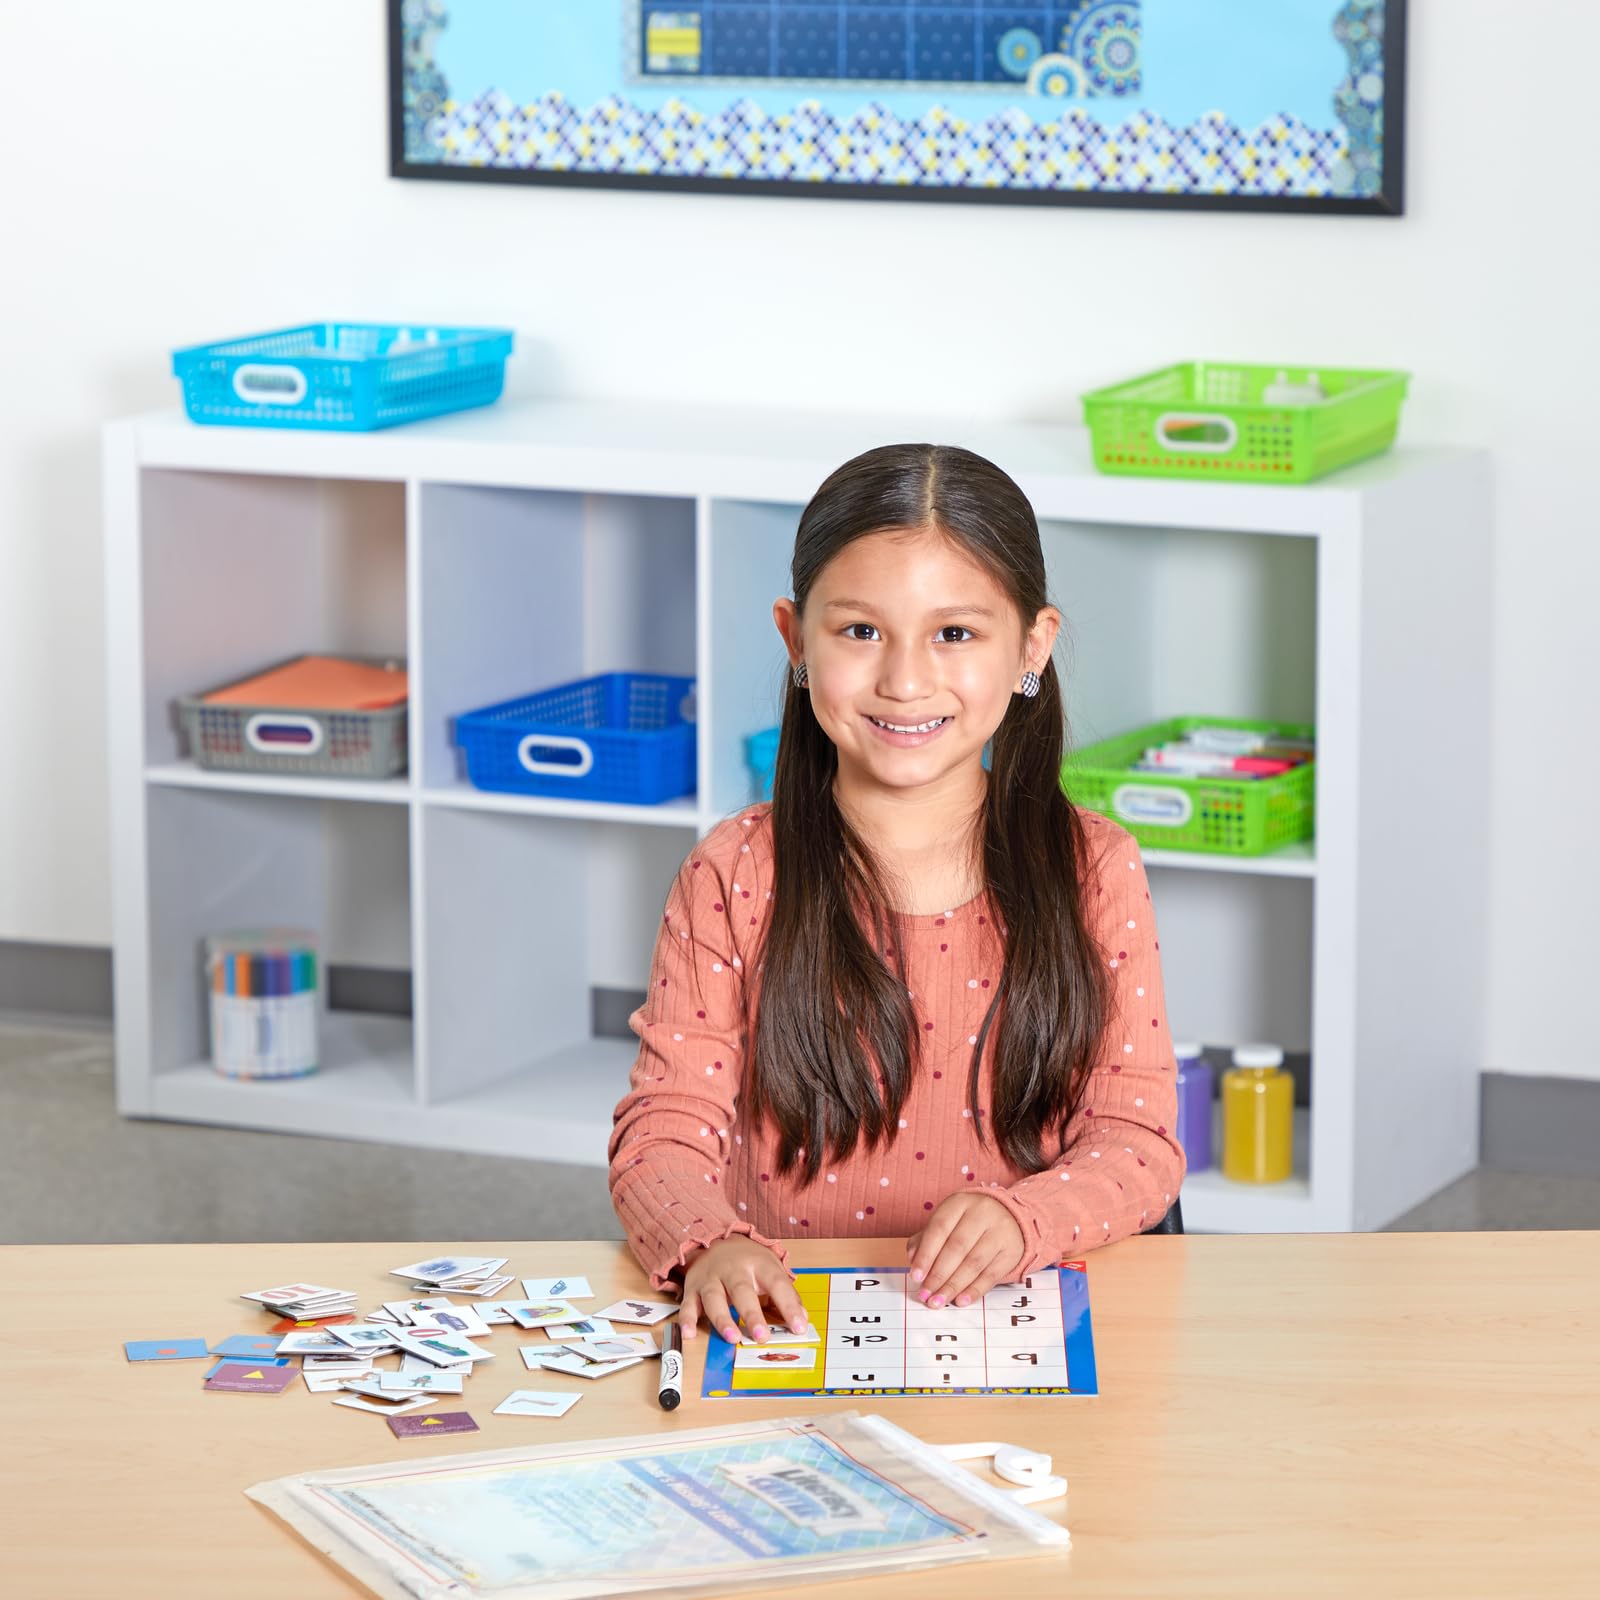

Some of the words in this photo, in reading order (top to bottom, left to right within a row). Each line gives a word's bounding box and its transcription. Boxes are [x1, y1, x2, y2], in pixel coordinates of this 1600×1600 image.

[855, 1279, 881, 1291] d
[1011, 1295, 1032, 1308] f
[849, 1316, 881, 1324] m
[1010, 1314, 1037, 1327] d
[841, 1335, 888, 1348] ck
[935, 1334, 958, 1342] u
[935, 1353, 958, 1361] u
[1011, 1353, 1038, 1365] b
[852, 1374, 875, 1382] n
[943, 1373, 951, 1384] i
[812, 1387, 954, 1396] MISSING?
